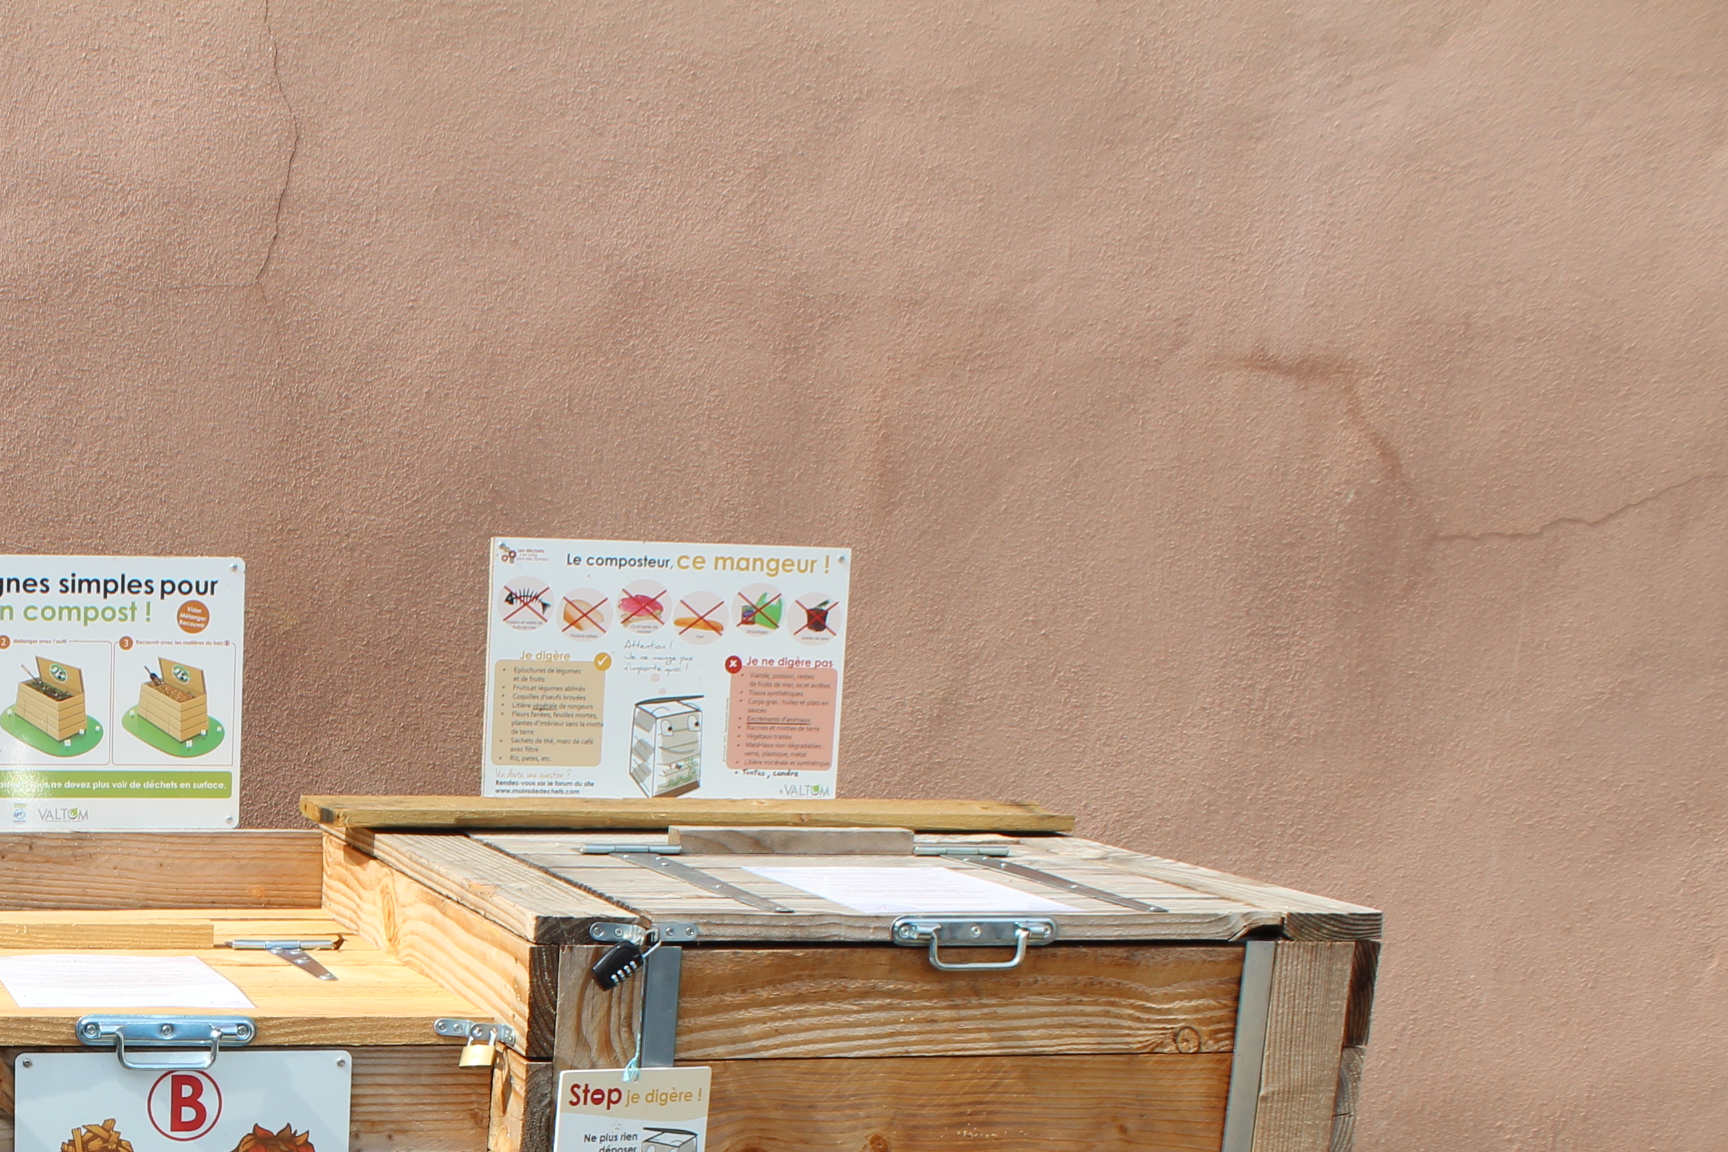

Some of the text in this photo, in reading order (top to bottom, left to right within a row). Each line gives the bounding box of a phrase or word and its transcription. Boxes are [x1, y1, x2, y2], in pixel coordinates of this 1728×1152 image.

[567, 553, 582, 566] Le
[586, 554, 674, 570] composteur,
[676, 554, 706, 571] ce
[714, 555, 817, 577] mangeur
[824, 555, 830, 574] !
[58, 572, 154, 600] simples
[160, 578, 218, 600] pour
[23, 601, 138, 627] compost
[145, 601, 152, 622] !
[187, 606, 202, 614] Vider
[1, 638, 6, 647] 2
[124, 638, 129, 647] 3
[624, 639, 666, 650] Attention
[520, 650, 570, 662] Je digère
[624, 652, 636, 660] Je
[653, 655, 677, 665] mange
[746, 656, 833, 669] Je ne digère pas
[556, 667, 581, 675] légumes
[538, 685, 563, 693] légumes
[512, 693, 539, 701] Coquilles
[511, 720, 532, 728] plantes
[64, 780, 90, 789] devez
[92, 780, 110, 790] plus
[112, 780, 128, 789] voir
[129, 780, 141, 789] de
[143, 780, 178, 790] déchets
[193, 781, 226, 790] surface.
[495, 779, 536, 787] Rendez-vous
[569, 1083, 702, 1110] Stop je digère !
[169, 1074, 207, 1133] B
[583, 1132, 638, 1145] Ne plus rien
